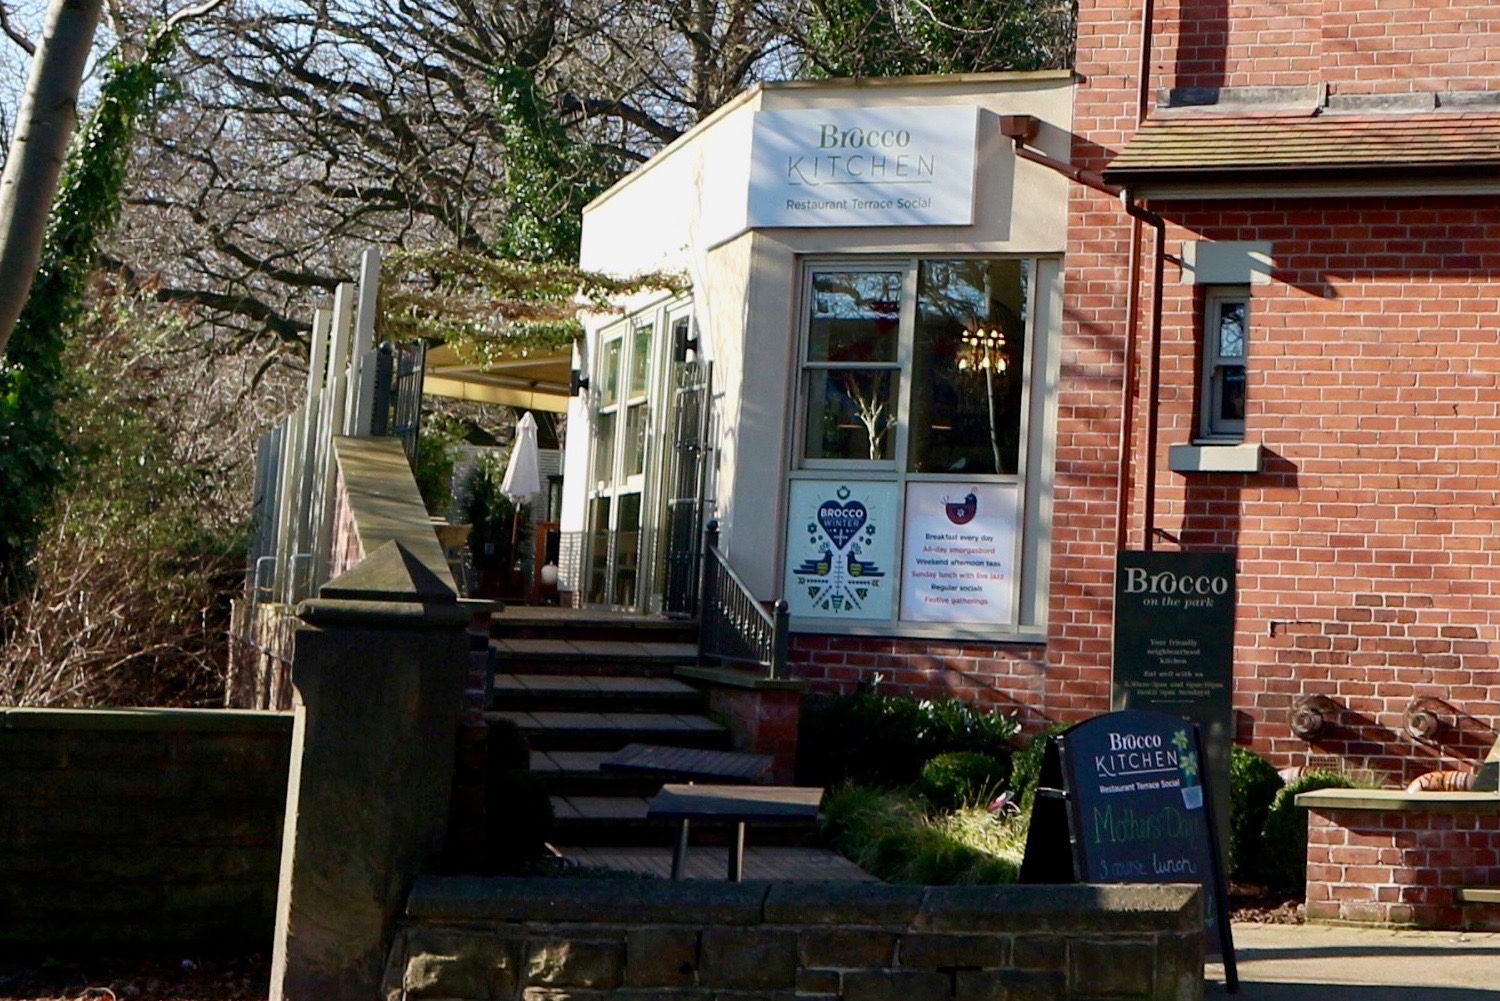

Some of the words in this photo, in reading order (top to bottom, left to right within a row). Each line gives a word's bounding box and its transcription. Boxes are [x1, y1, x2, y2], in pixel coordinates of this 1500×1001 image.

[816, 123, 911, 149] Brocco
[788, 154, 936, 185] KITCHEN
[786, 198, 848, 210] Restaurant
[852, 198, 893, 210] Terrace
[897, 197, 932, 209] Social
[820, 507, 864, 518] BROCCO
[823, 519, 860, 528] WINTER
[925, 532, 958, 541] Breakfast
[960, 534, 979, 542] every
[981, 534, 994, 542] day
[949, 546, 996, 555] smorgasbord
[916, 558, 949, 566] Weekend
[950, 559, 985, 567] afternoon
[911, 570, 937, 579] Sunday
[938, 571, 957, 579] lunch
[959, 571, 974, 579] with
[990, 572, 1004, 580] jazz
[1123, 566, 1229, 596] Brocco
[931, 583, 958, 592] Regular
[960, 584, 983, 592] socials
[925, 595, 949, 604] Festive
[951, 596, 988, 606] gatherings
[1143, 598, 1158, 607] on
[1161, 596, 1180, 607] the
[1184, 597, 1214, 610] park
[1108, 732, 1162, 751] Brocco
[1095, 750, 1178, 777] KITCHEN
[1099, 783, 1135, 794] Restaurant
[1135, 781, 1160, 790] Terrace
[1160, 778, 1180, 789] Social
[1152, 852, 1198, 875] lunch
